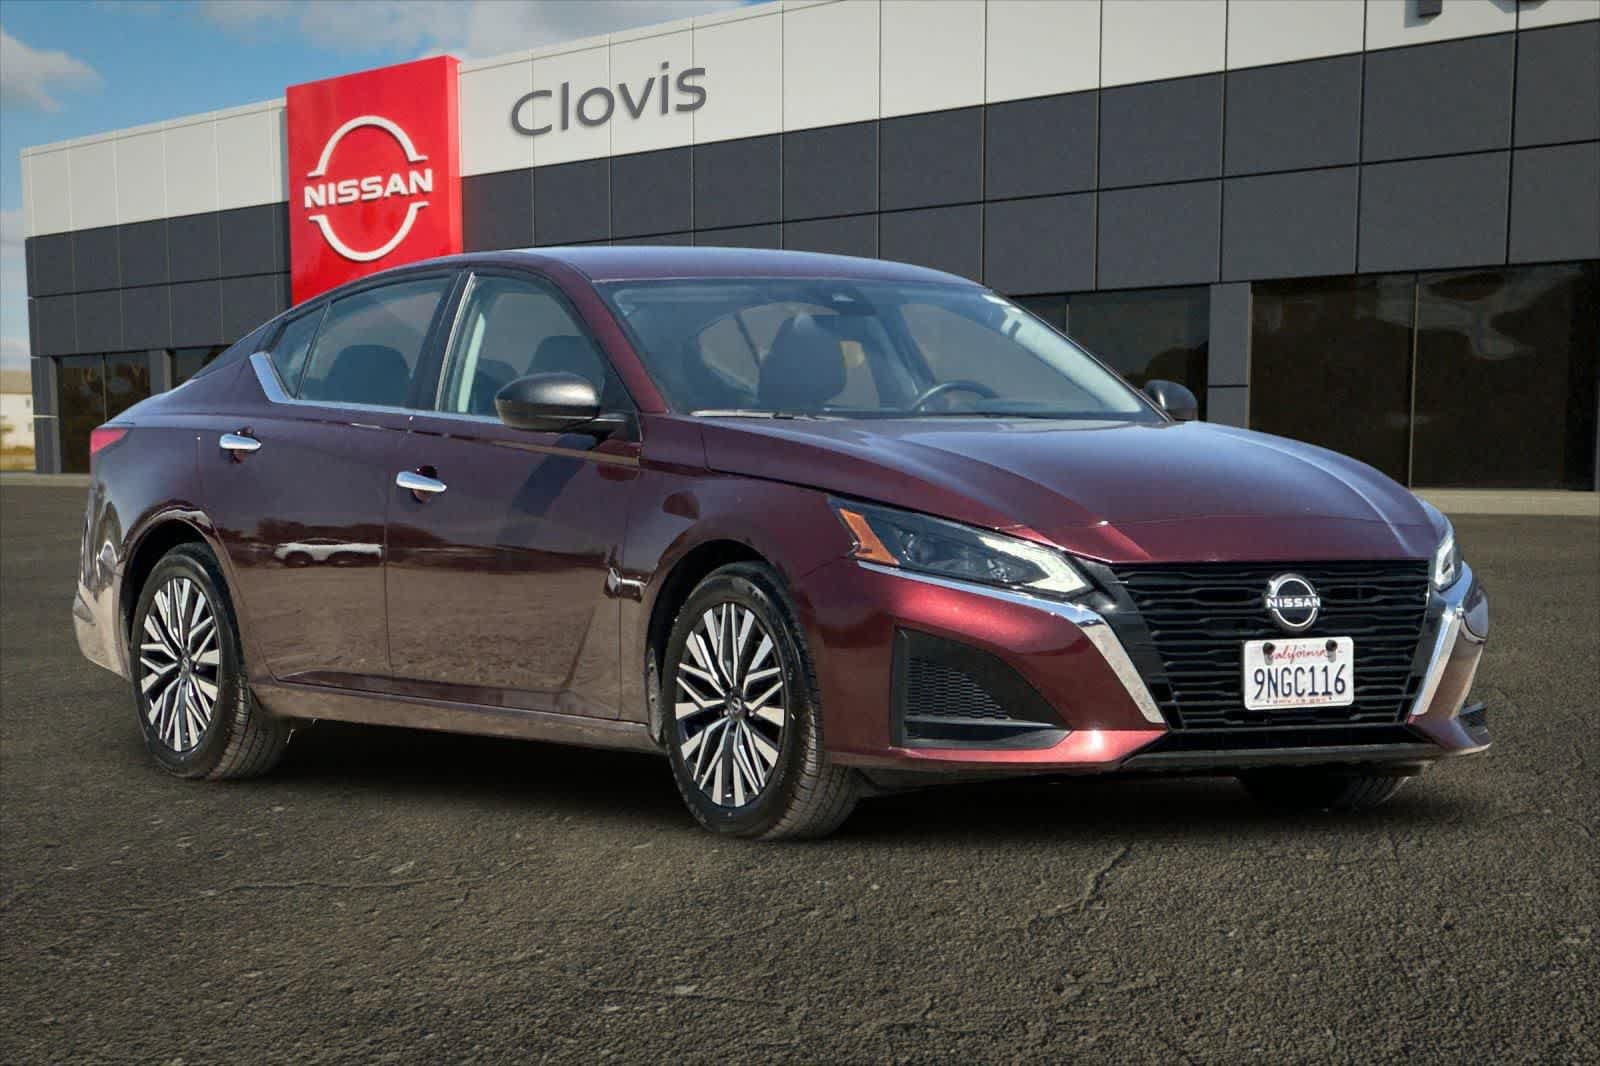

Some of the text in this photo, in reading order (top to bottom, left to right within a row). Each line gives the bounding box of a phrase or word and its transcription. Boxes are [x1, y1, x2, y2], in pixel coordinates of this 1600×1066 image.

[511, 62, 707, 136] Clovis
[304, 168, 433, 208] NISSAN
[1266, 596, 1321, 608] NISSAN
[1268, 643, 1329, 664] alifornia
[1254, 664, 1346, 700] 9NGC116
